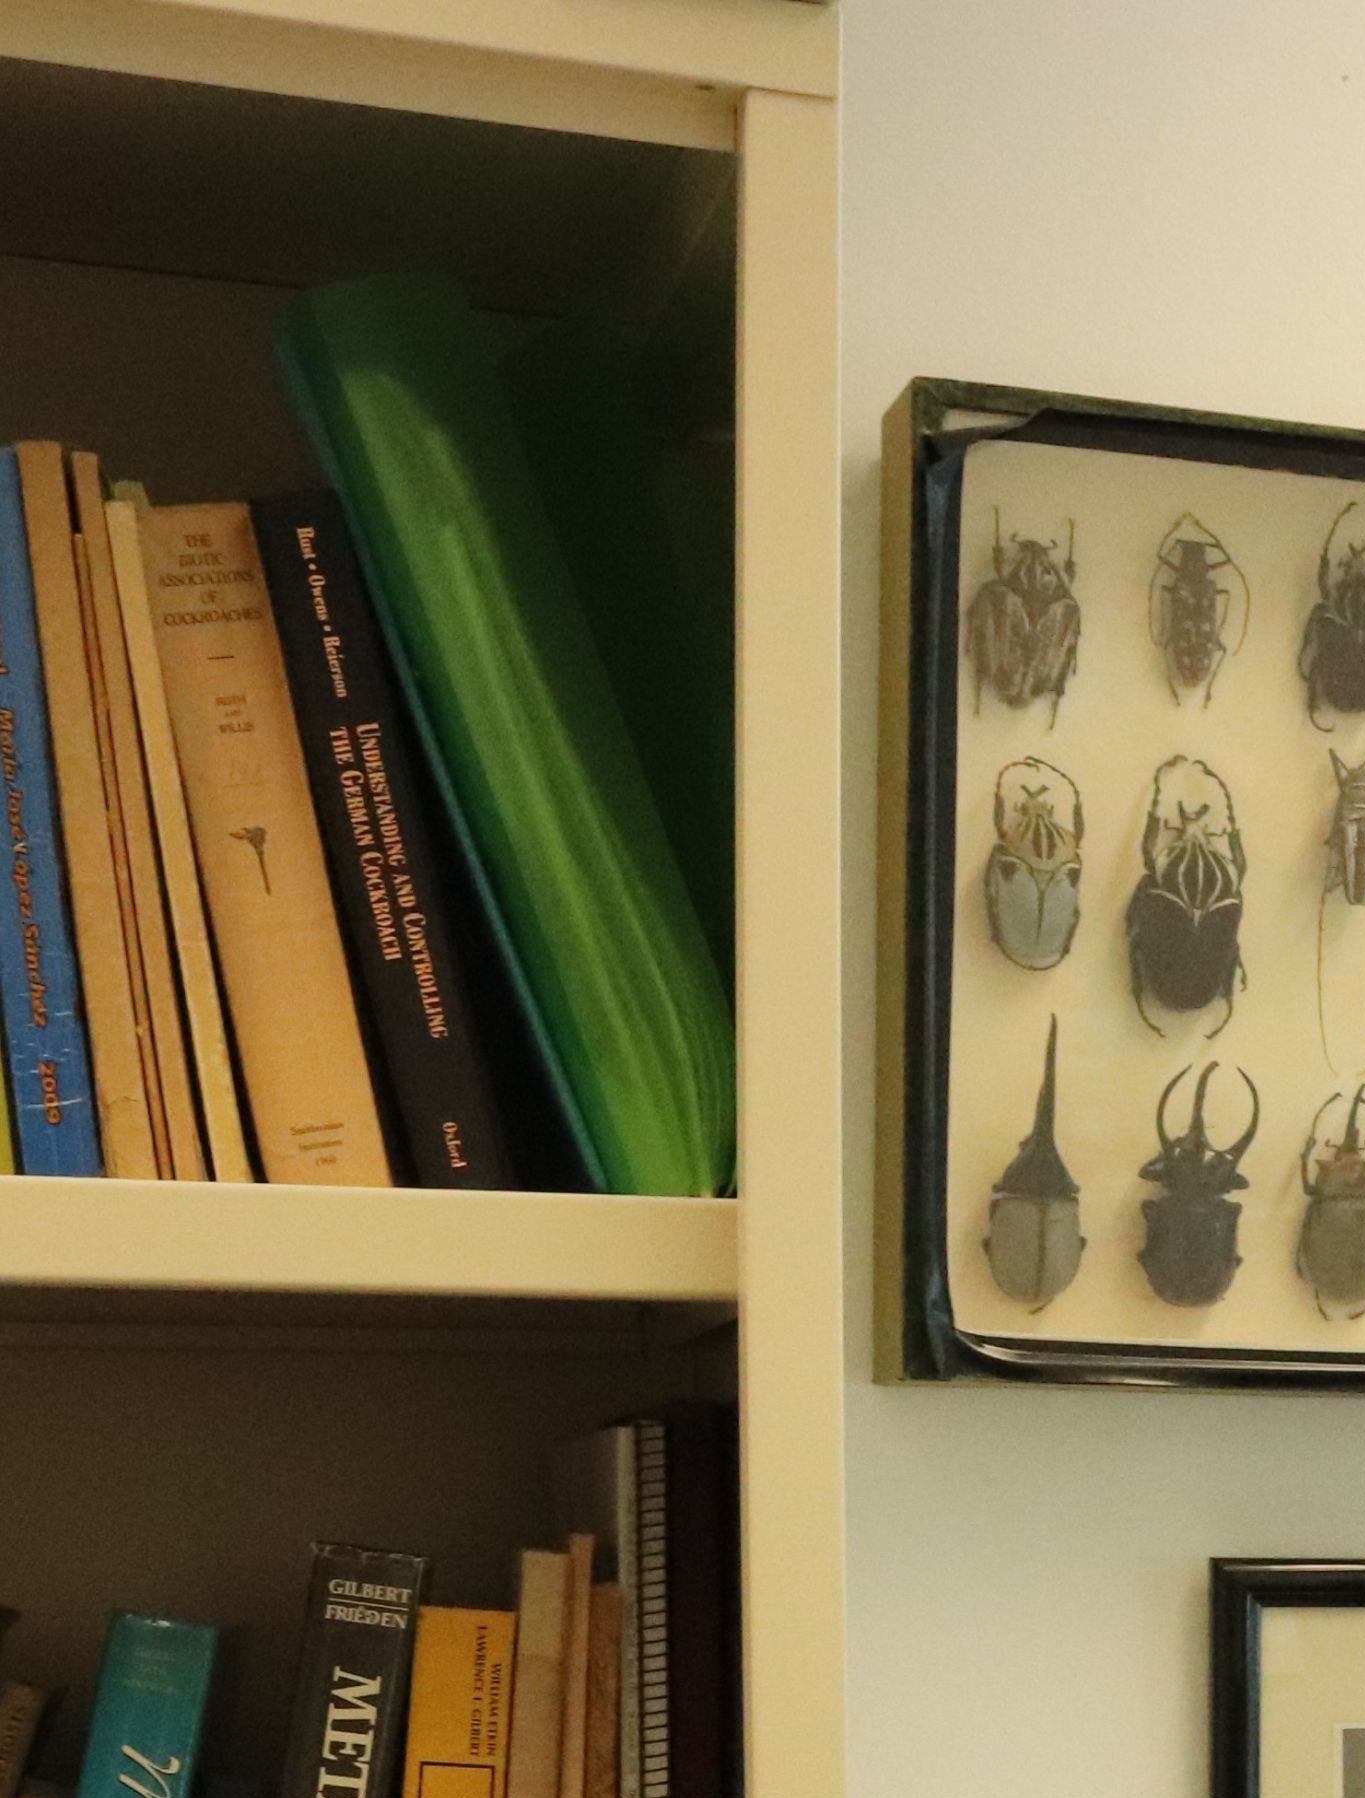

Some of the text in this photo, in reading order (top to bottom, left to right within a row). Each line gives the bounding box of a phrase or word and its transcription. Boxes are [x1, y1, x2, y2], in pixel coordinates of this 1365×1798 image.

[158, 570, 253, 588] ASSOCIATIONS
[164, 608, 262, 626] COCKROACHES
[308, 574, 329, 621] Owens
[322, 636, 348, 698] Reierson
[339, 770, 375, 846] GERMAN
[360, 851, 402, 961] COCKROACH
[356, 722, 406, 866] UNDERSTANDING
[402, 912, 448, 1039] CONTROLLING
[38, 1059, 62, 1125] 2009
[442, 1122, 467, 1168] Oxford
[329, 1578, 412, 1604] GILBERT
[324, 1603, 408, 1630] FRIEDEN
